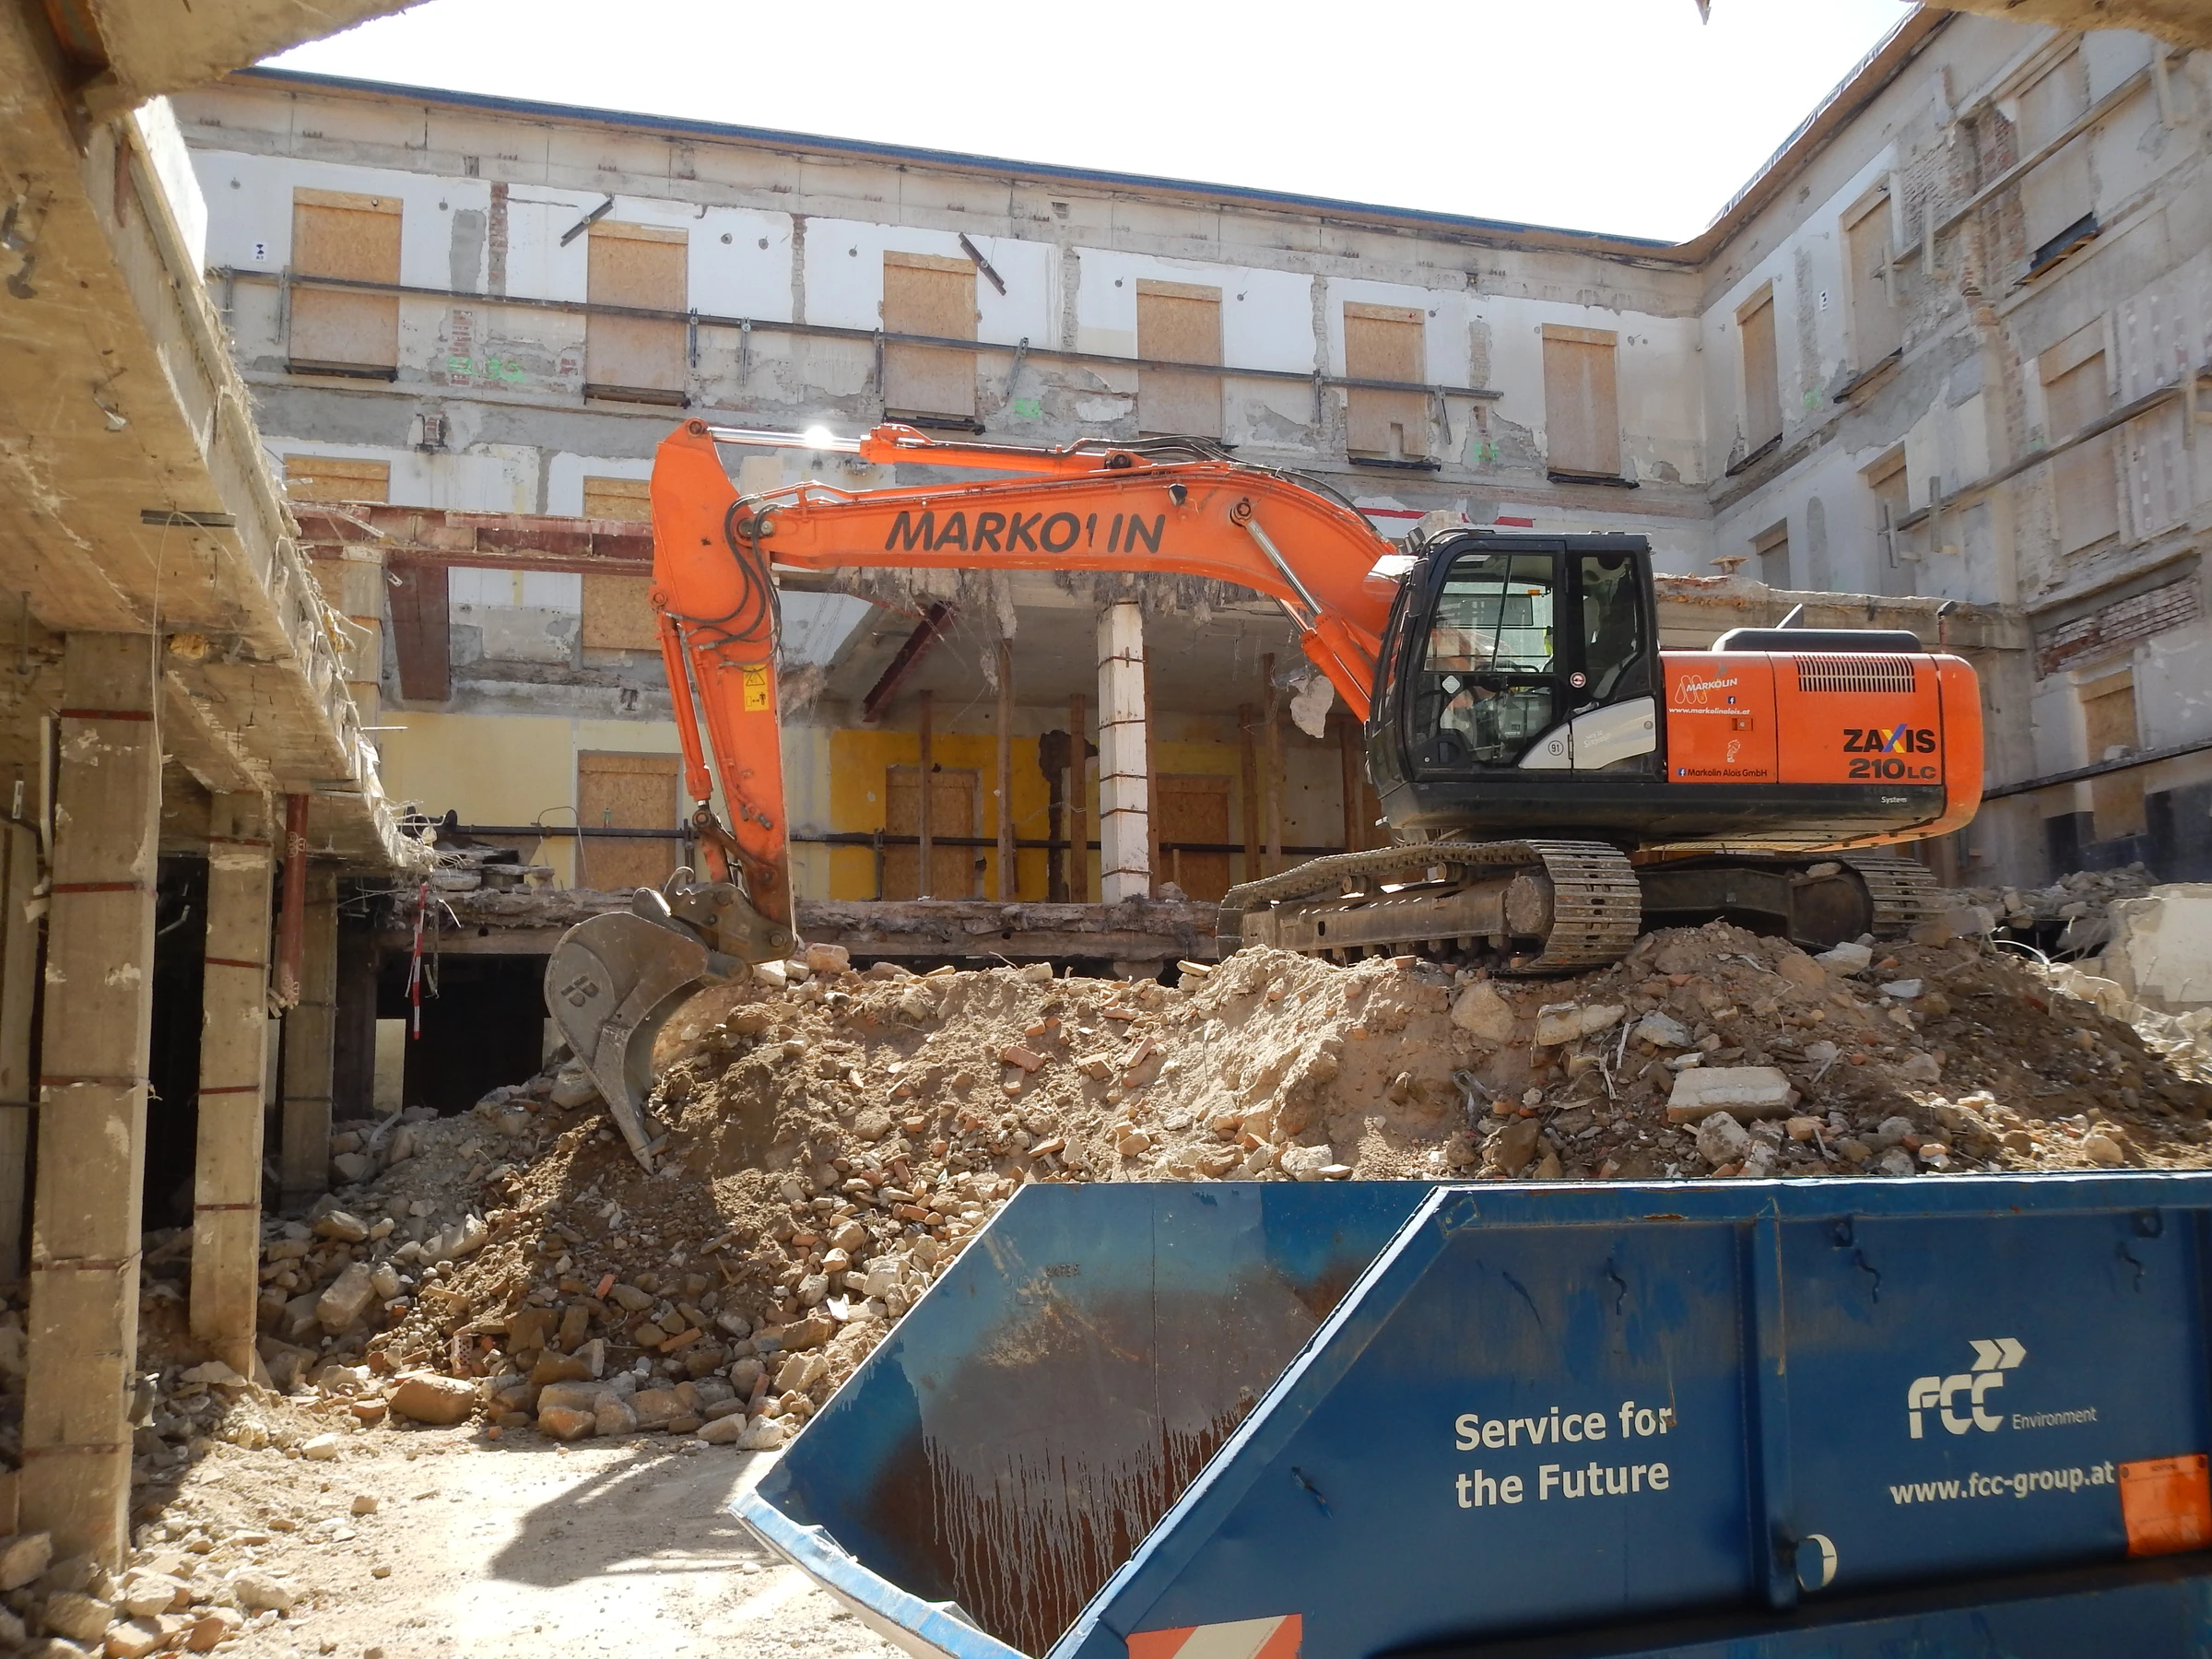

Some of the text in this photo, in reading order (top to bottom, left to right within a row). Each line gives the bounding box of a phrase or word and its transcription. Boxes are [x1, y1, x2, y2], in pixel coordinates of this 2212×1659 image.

[1668, 707, 1750, 715] www.markolinalois.at
[1843, 724, 1936, 754] ZAXIS
[1688, 769, 1722, 777] Markolin
[1723, 769, 1741, 777] Alois
[1742, 769, 1768, 777] GmbH
[1880, 796, 1907, 805] System
[1907, 1371, 2005, 1440] FCC
[2012, 1406, 2098, 1430] Environment
[1454, 1400, 1673, 1452] Service for
[1455, 1461, 1670, 1509] the Future
[1889, 1460, 2116, 1505] www.fcc-group.at
